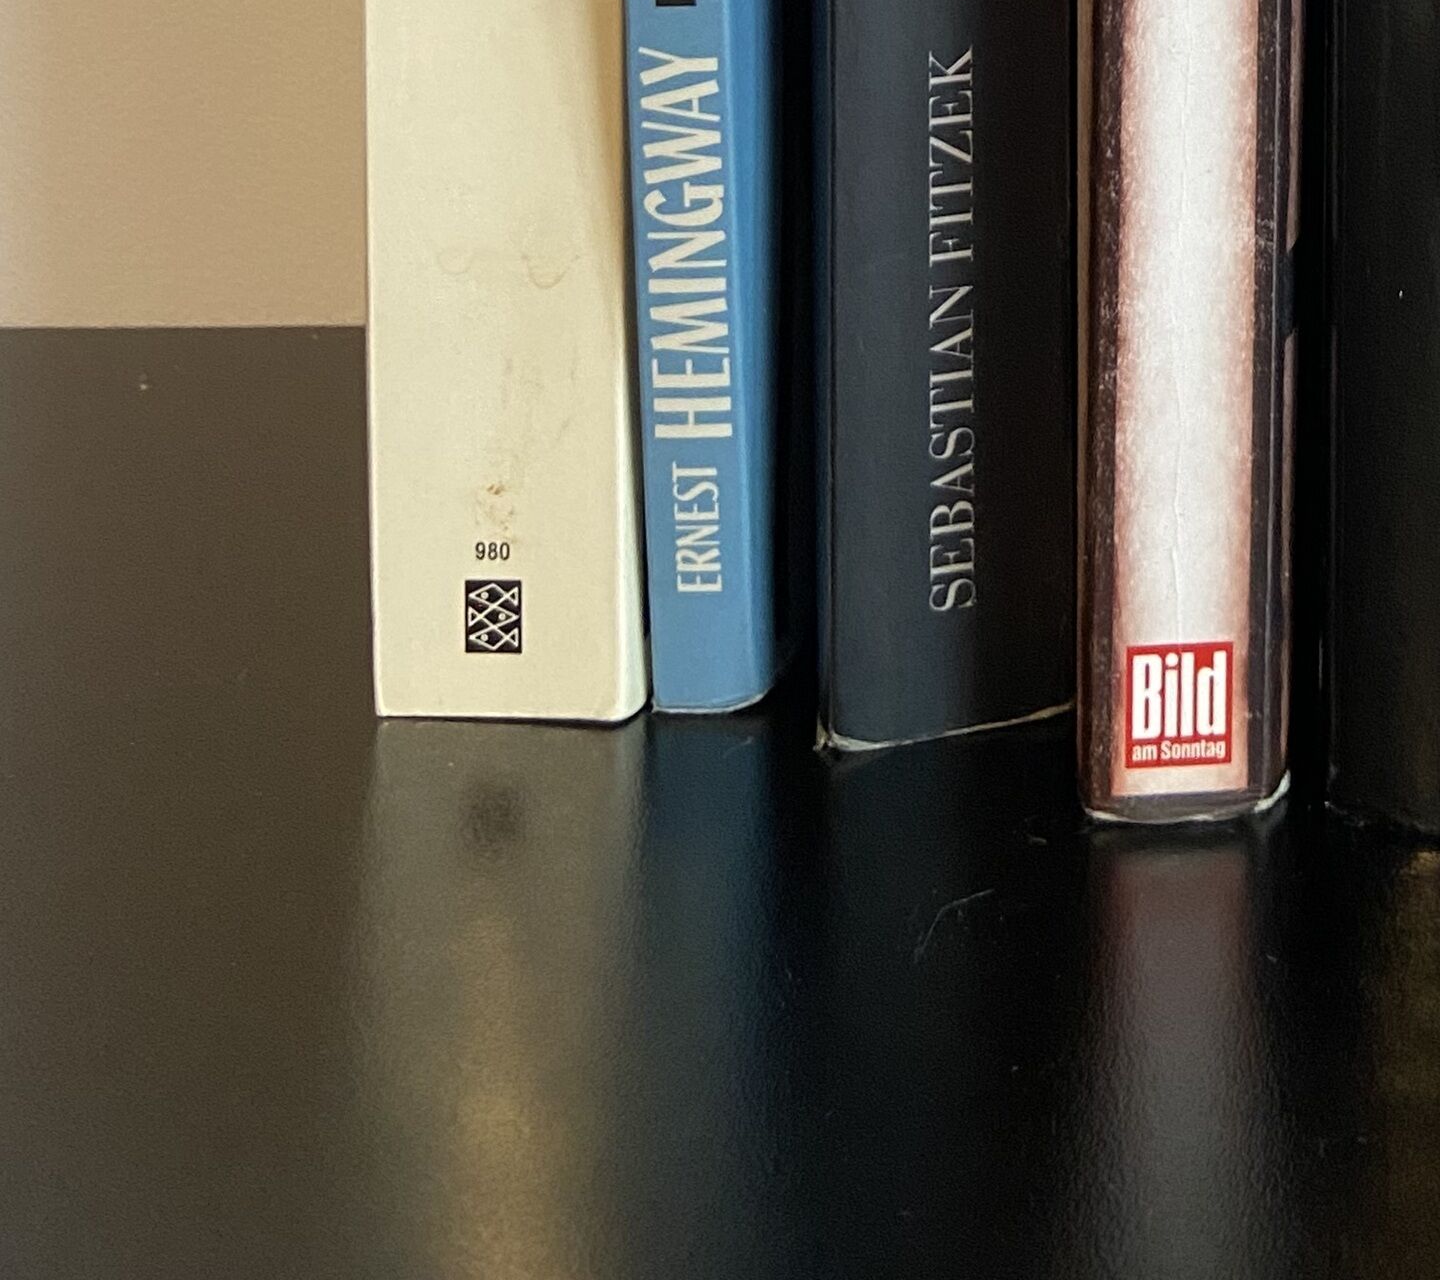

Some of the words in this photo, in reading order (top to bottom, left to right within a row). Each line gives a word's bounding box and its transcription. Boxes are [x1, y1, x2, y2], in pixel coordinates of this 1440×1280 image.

[928, 47, 975, 266] FITZEK
[638, 46, 733, 440] HEMINGWAY
[928, 285, 977, 613] SEBASTIAN
[475, 541, 510, 562] 980
[671, 461, 724, 595] ERNEST
[1132, 650, 1227, 740] Bild
[1132, 744, 1158, 761] am
[1160, 739, 1226, 759] Sonntag
